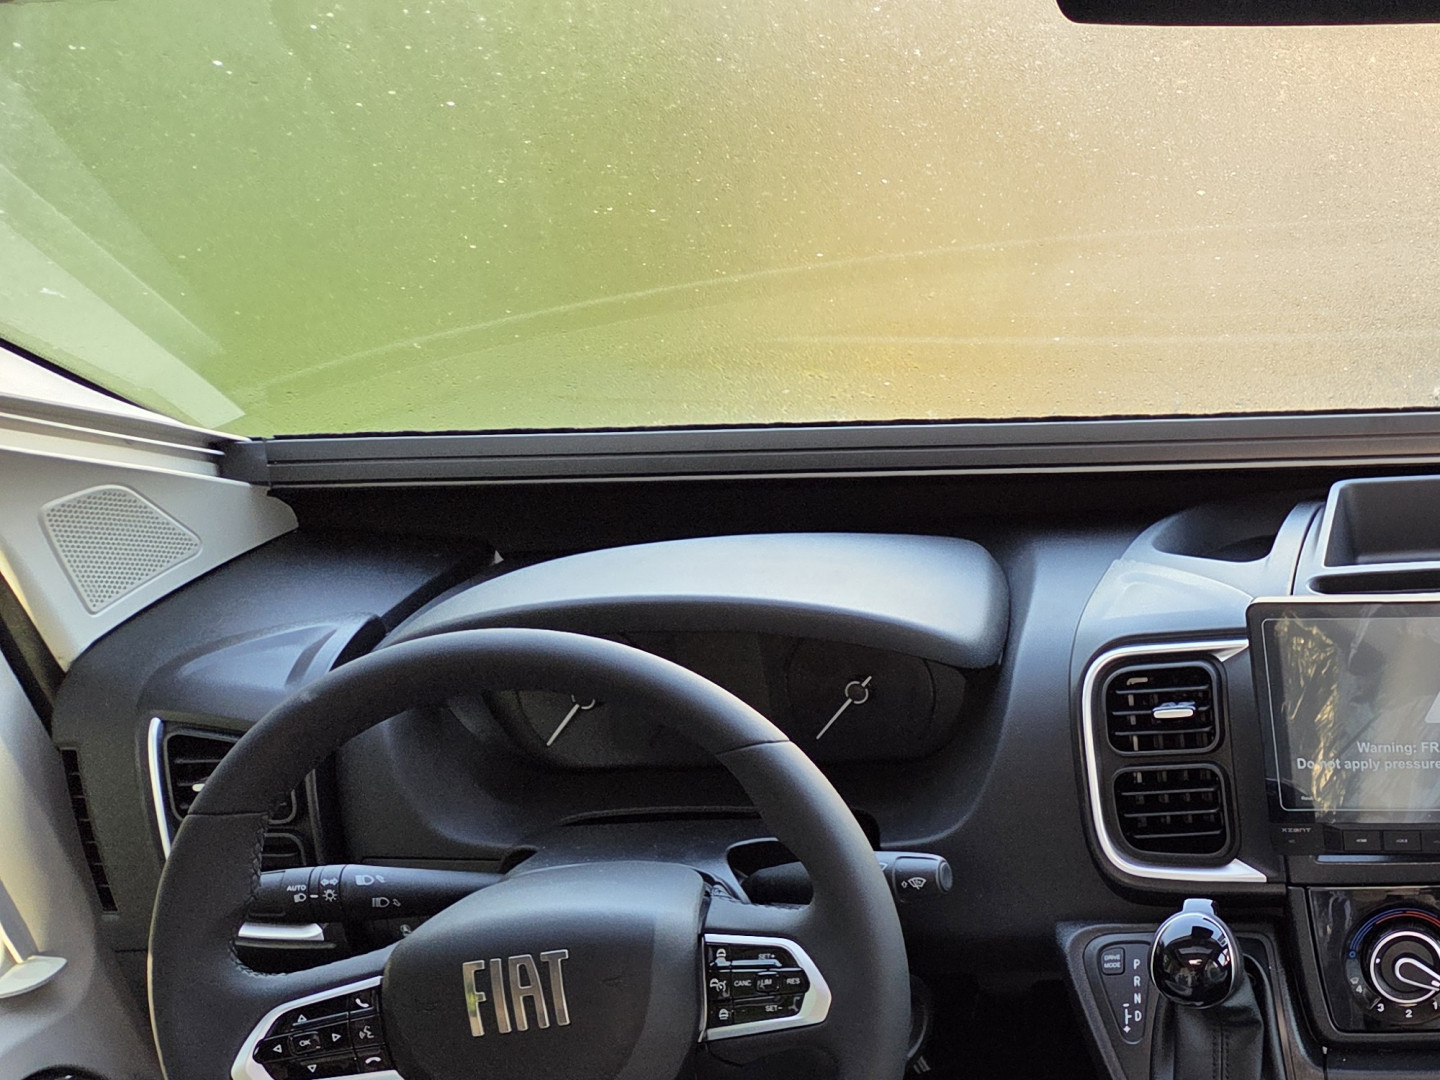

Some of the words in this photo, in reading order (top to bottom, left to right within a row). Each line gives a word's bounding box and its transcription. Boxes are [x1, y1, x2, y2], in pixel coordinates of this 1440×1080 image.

[1357, 741, 1417, 756] Warning:
[1297, 758, 1315, 770] Do
[1319, 758, 1341, 769] not
[1344, 758, 1380, 772] apply
[286, 884, 307, 892] AUTO
[1133, 958, 1141, 970] P
[1133, 975, 1141, 987] R
[462, 949, 571, 1037] FIAT
[1356, 984, 1363, 994] 4
[1133, 993, 1142, 1004] N
[1376, 1003, 1385, 1012] 3
[1432, 1001, 1439, 1010] 1
[1134, 1010, 1143, 1022] D
[1405, 1009, 1413, 1018] 2
[299, 1039, 311, 1047] OK
